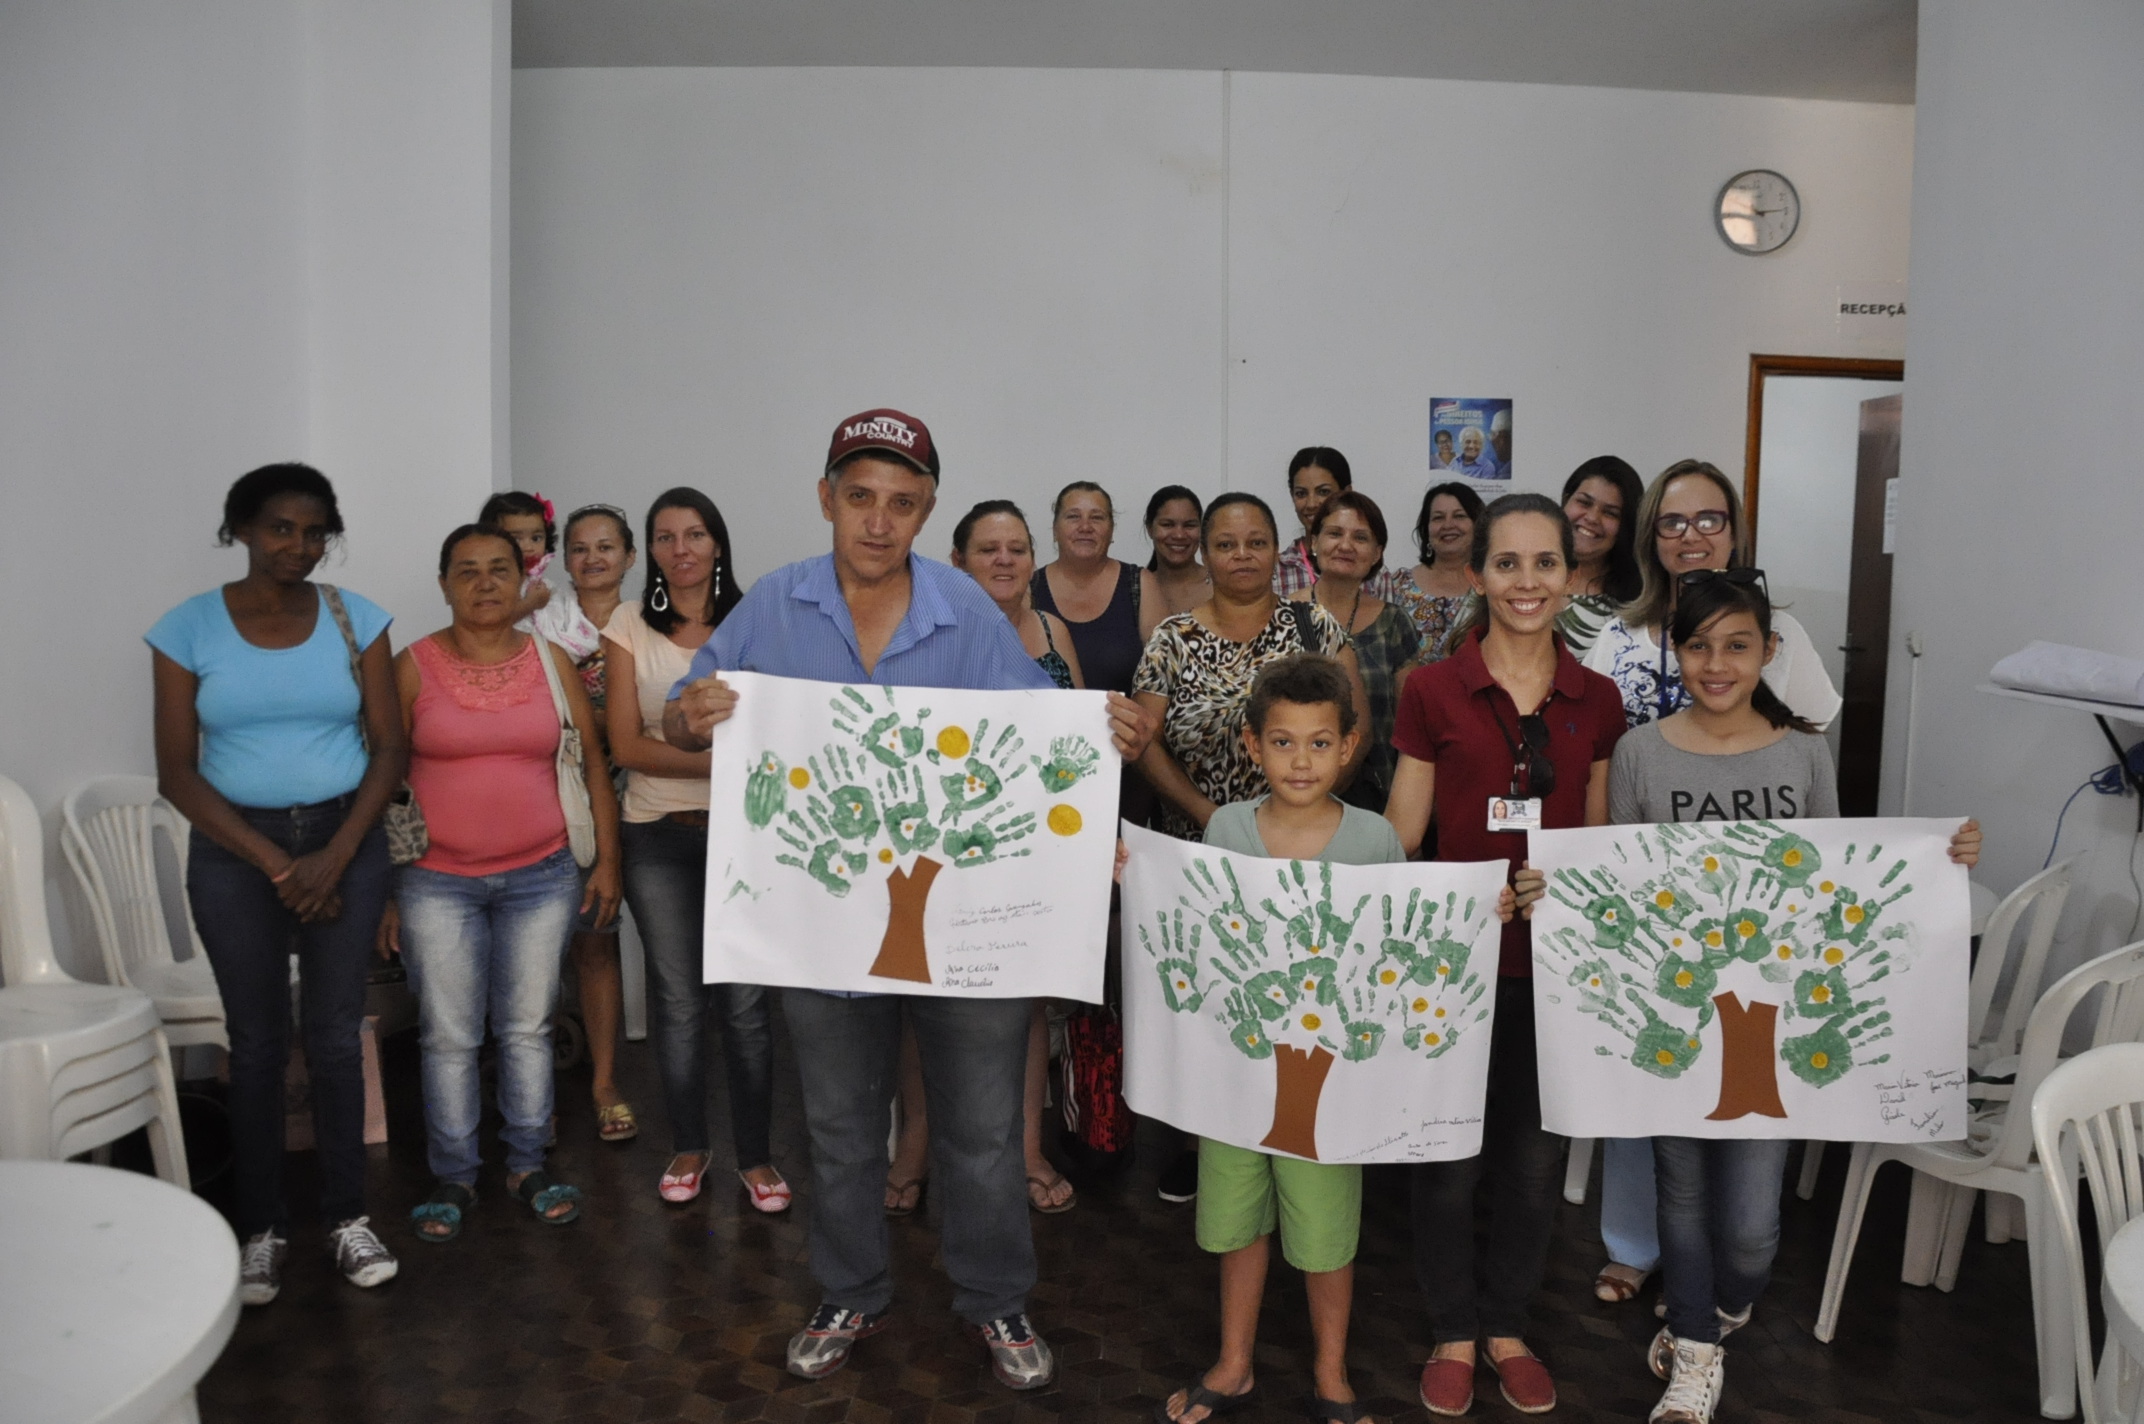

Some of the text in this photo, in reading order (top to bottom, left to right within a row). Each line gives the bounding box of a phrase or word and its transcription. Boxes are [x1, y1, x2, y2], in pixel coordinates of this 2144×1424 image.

[842, 421, 917, 441] MINUTY
[867, 431, 914, 448] COUNTRY
[1671, 785, 1798, 823] PARIS
